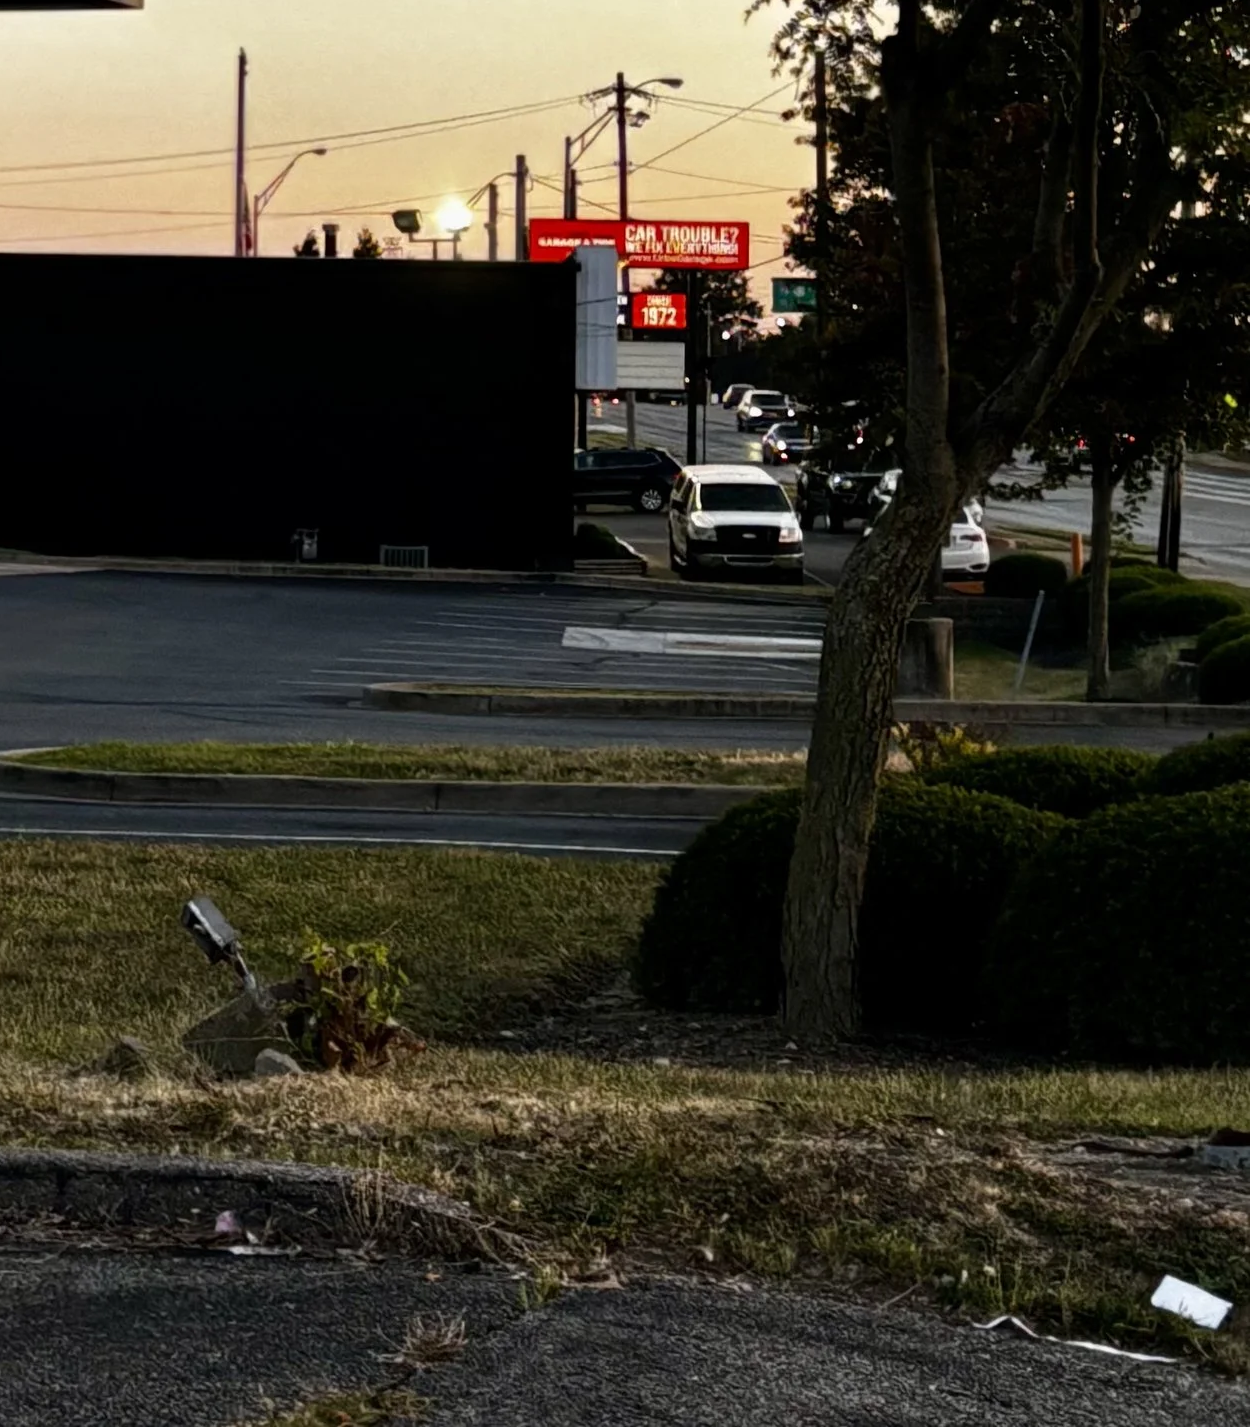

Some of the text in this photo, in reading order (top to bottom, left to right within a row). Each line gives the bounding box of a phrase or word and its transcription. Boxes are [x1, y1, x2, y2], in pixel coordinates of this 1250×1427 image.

[625, 224, 739, 244] CAR TROUBLE?
[640, 306, 677, 326] 1972
